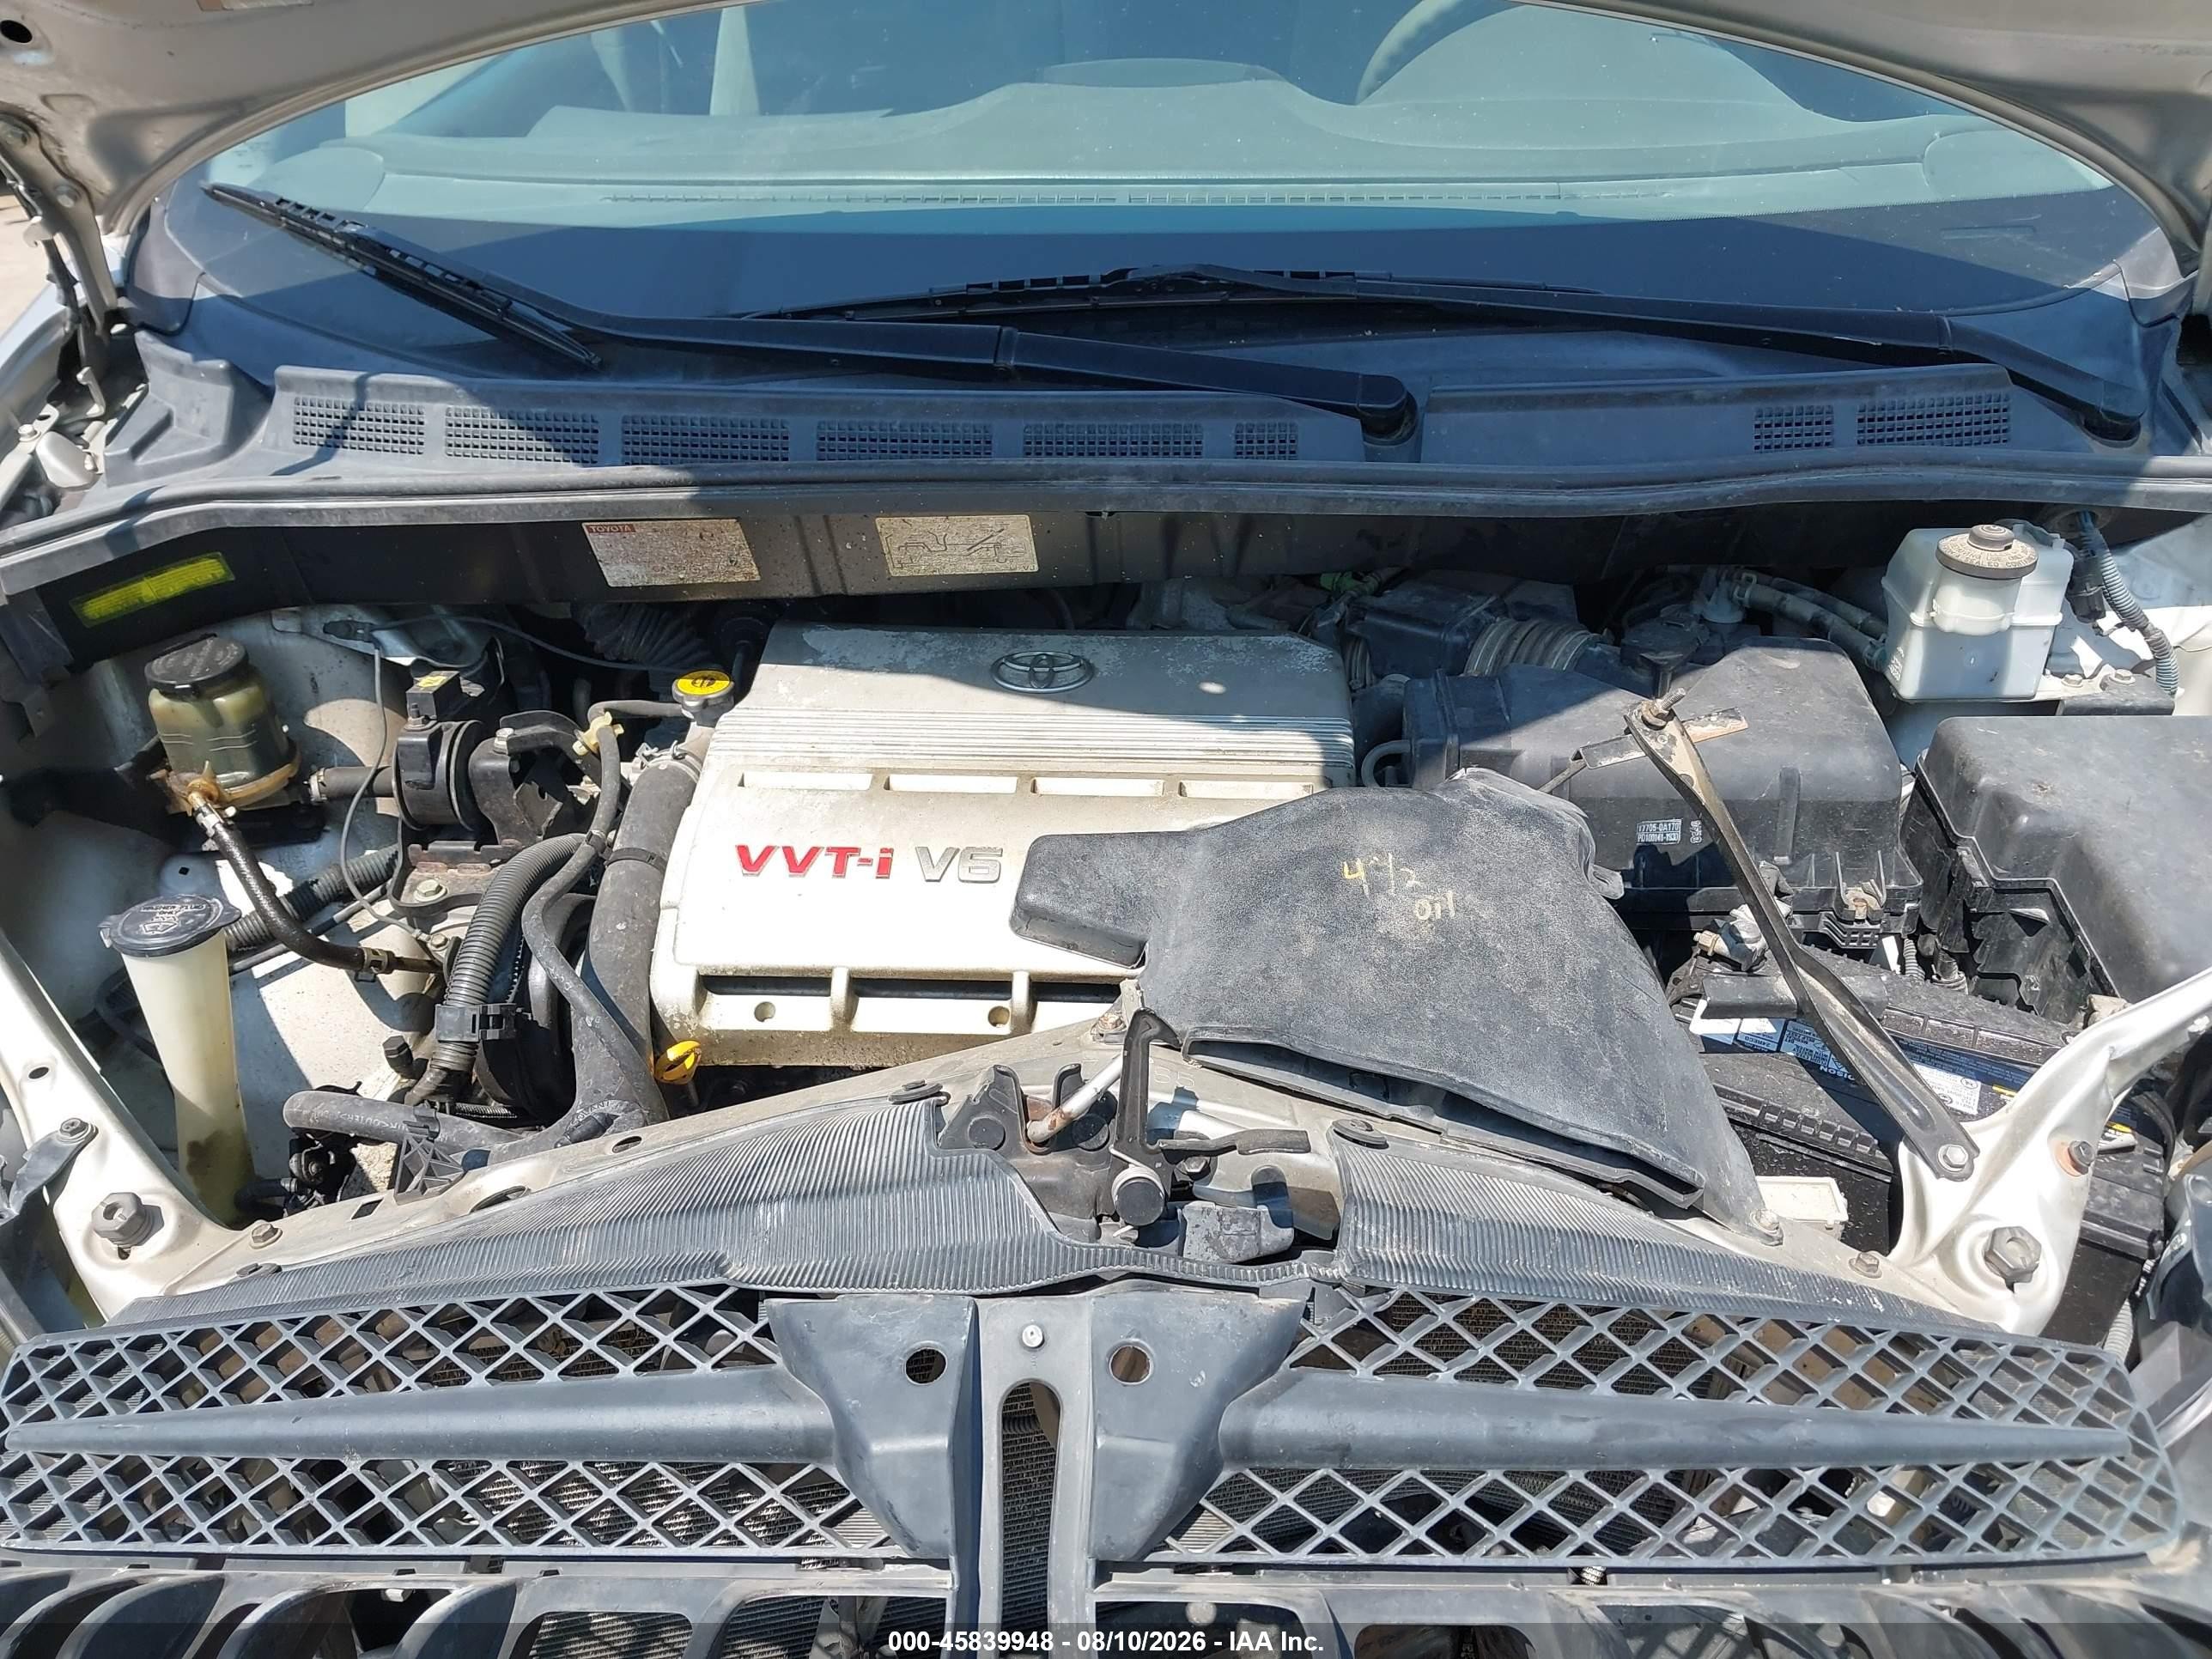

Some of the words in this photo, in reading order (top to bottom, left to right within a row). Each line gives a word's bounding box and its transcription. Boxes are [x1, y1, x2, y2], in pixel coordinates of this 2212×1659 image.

[591, 525, 632, 533] TOYOTA
[735, 844, 895, 879] VVT-i
[915, 846, 1002, 883] V6
